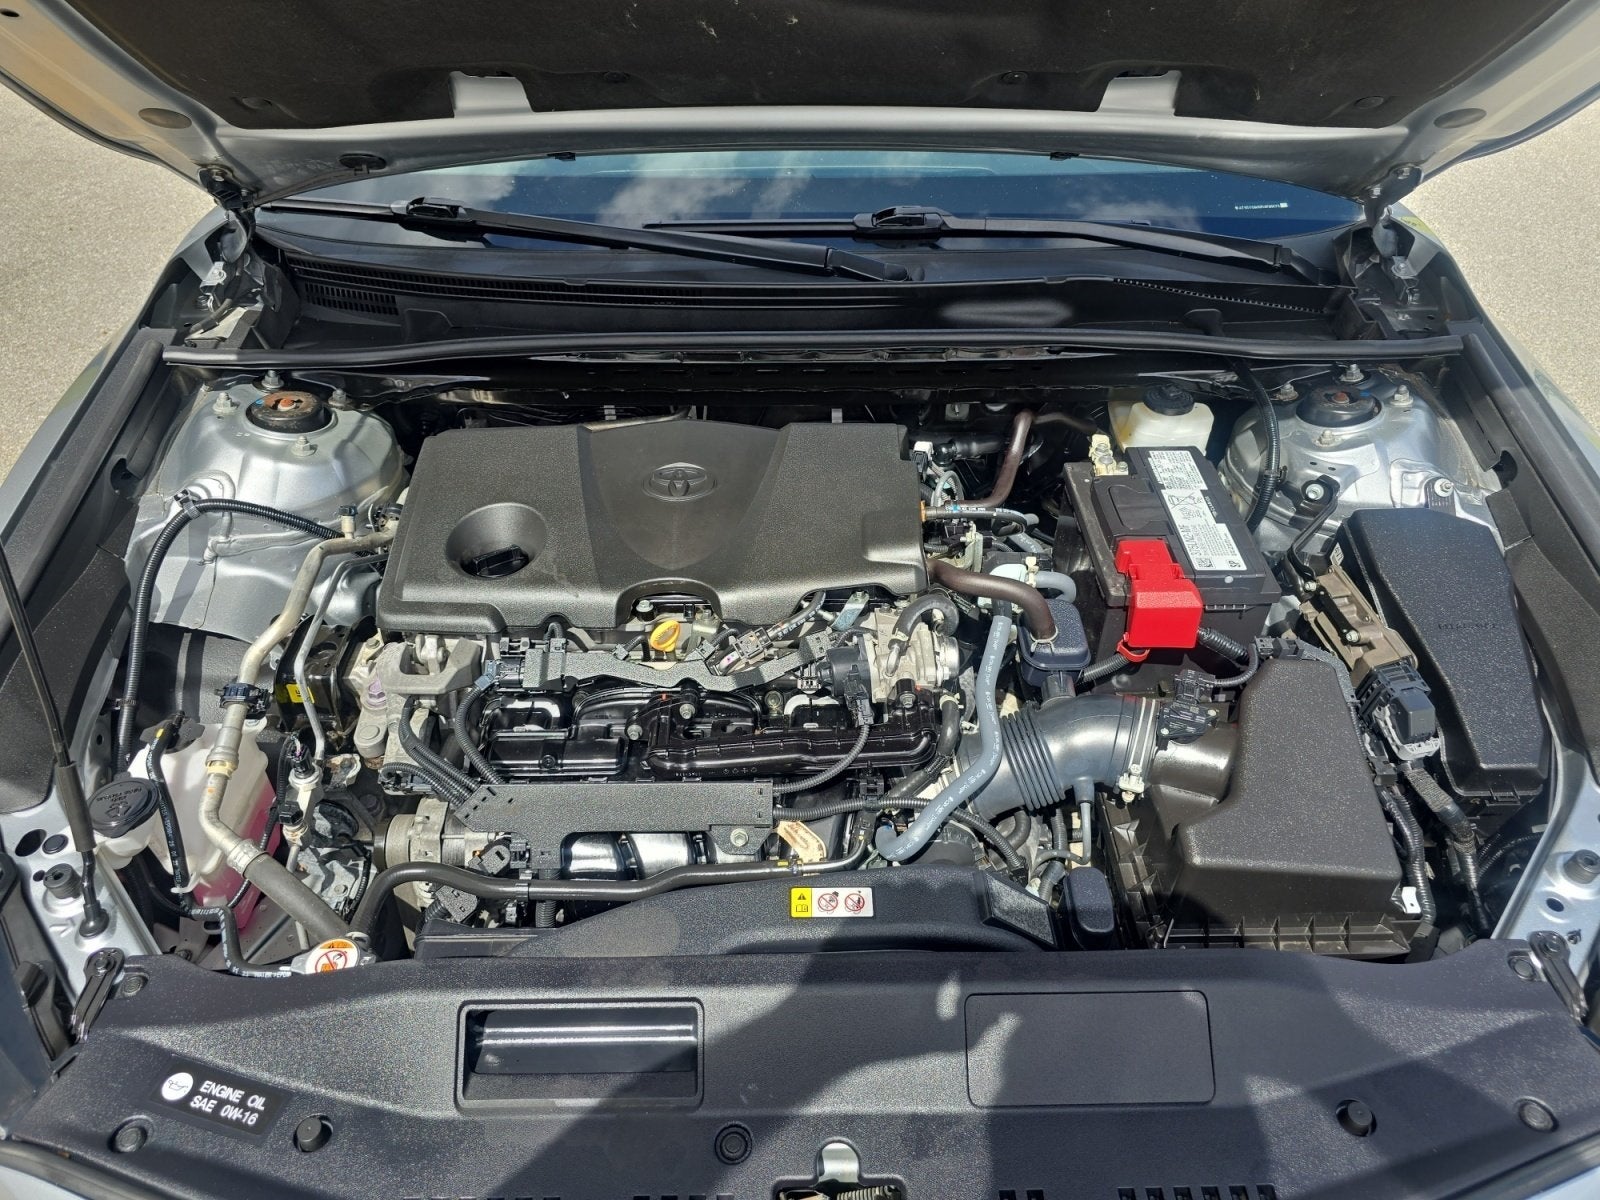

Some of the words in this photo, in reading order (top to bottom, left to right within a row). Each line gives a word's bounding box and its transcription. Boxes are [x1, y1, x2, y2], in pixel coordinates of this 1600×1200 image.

[190, 1095, 217, 1113] SAE
[220, 1105, 259, 1126] 0W-16
[200, 1080, 244, 1103] ENGINE
[247, 1094, 265, 1111] OIL
